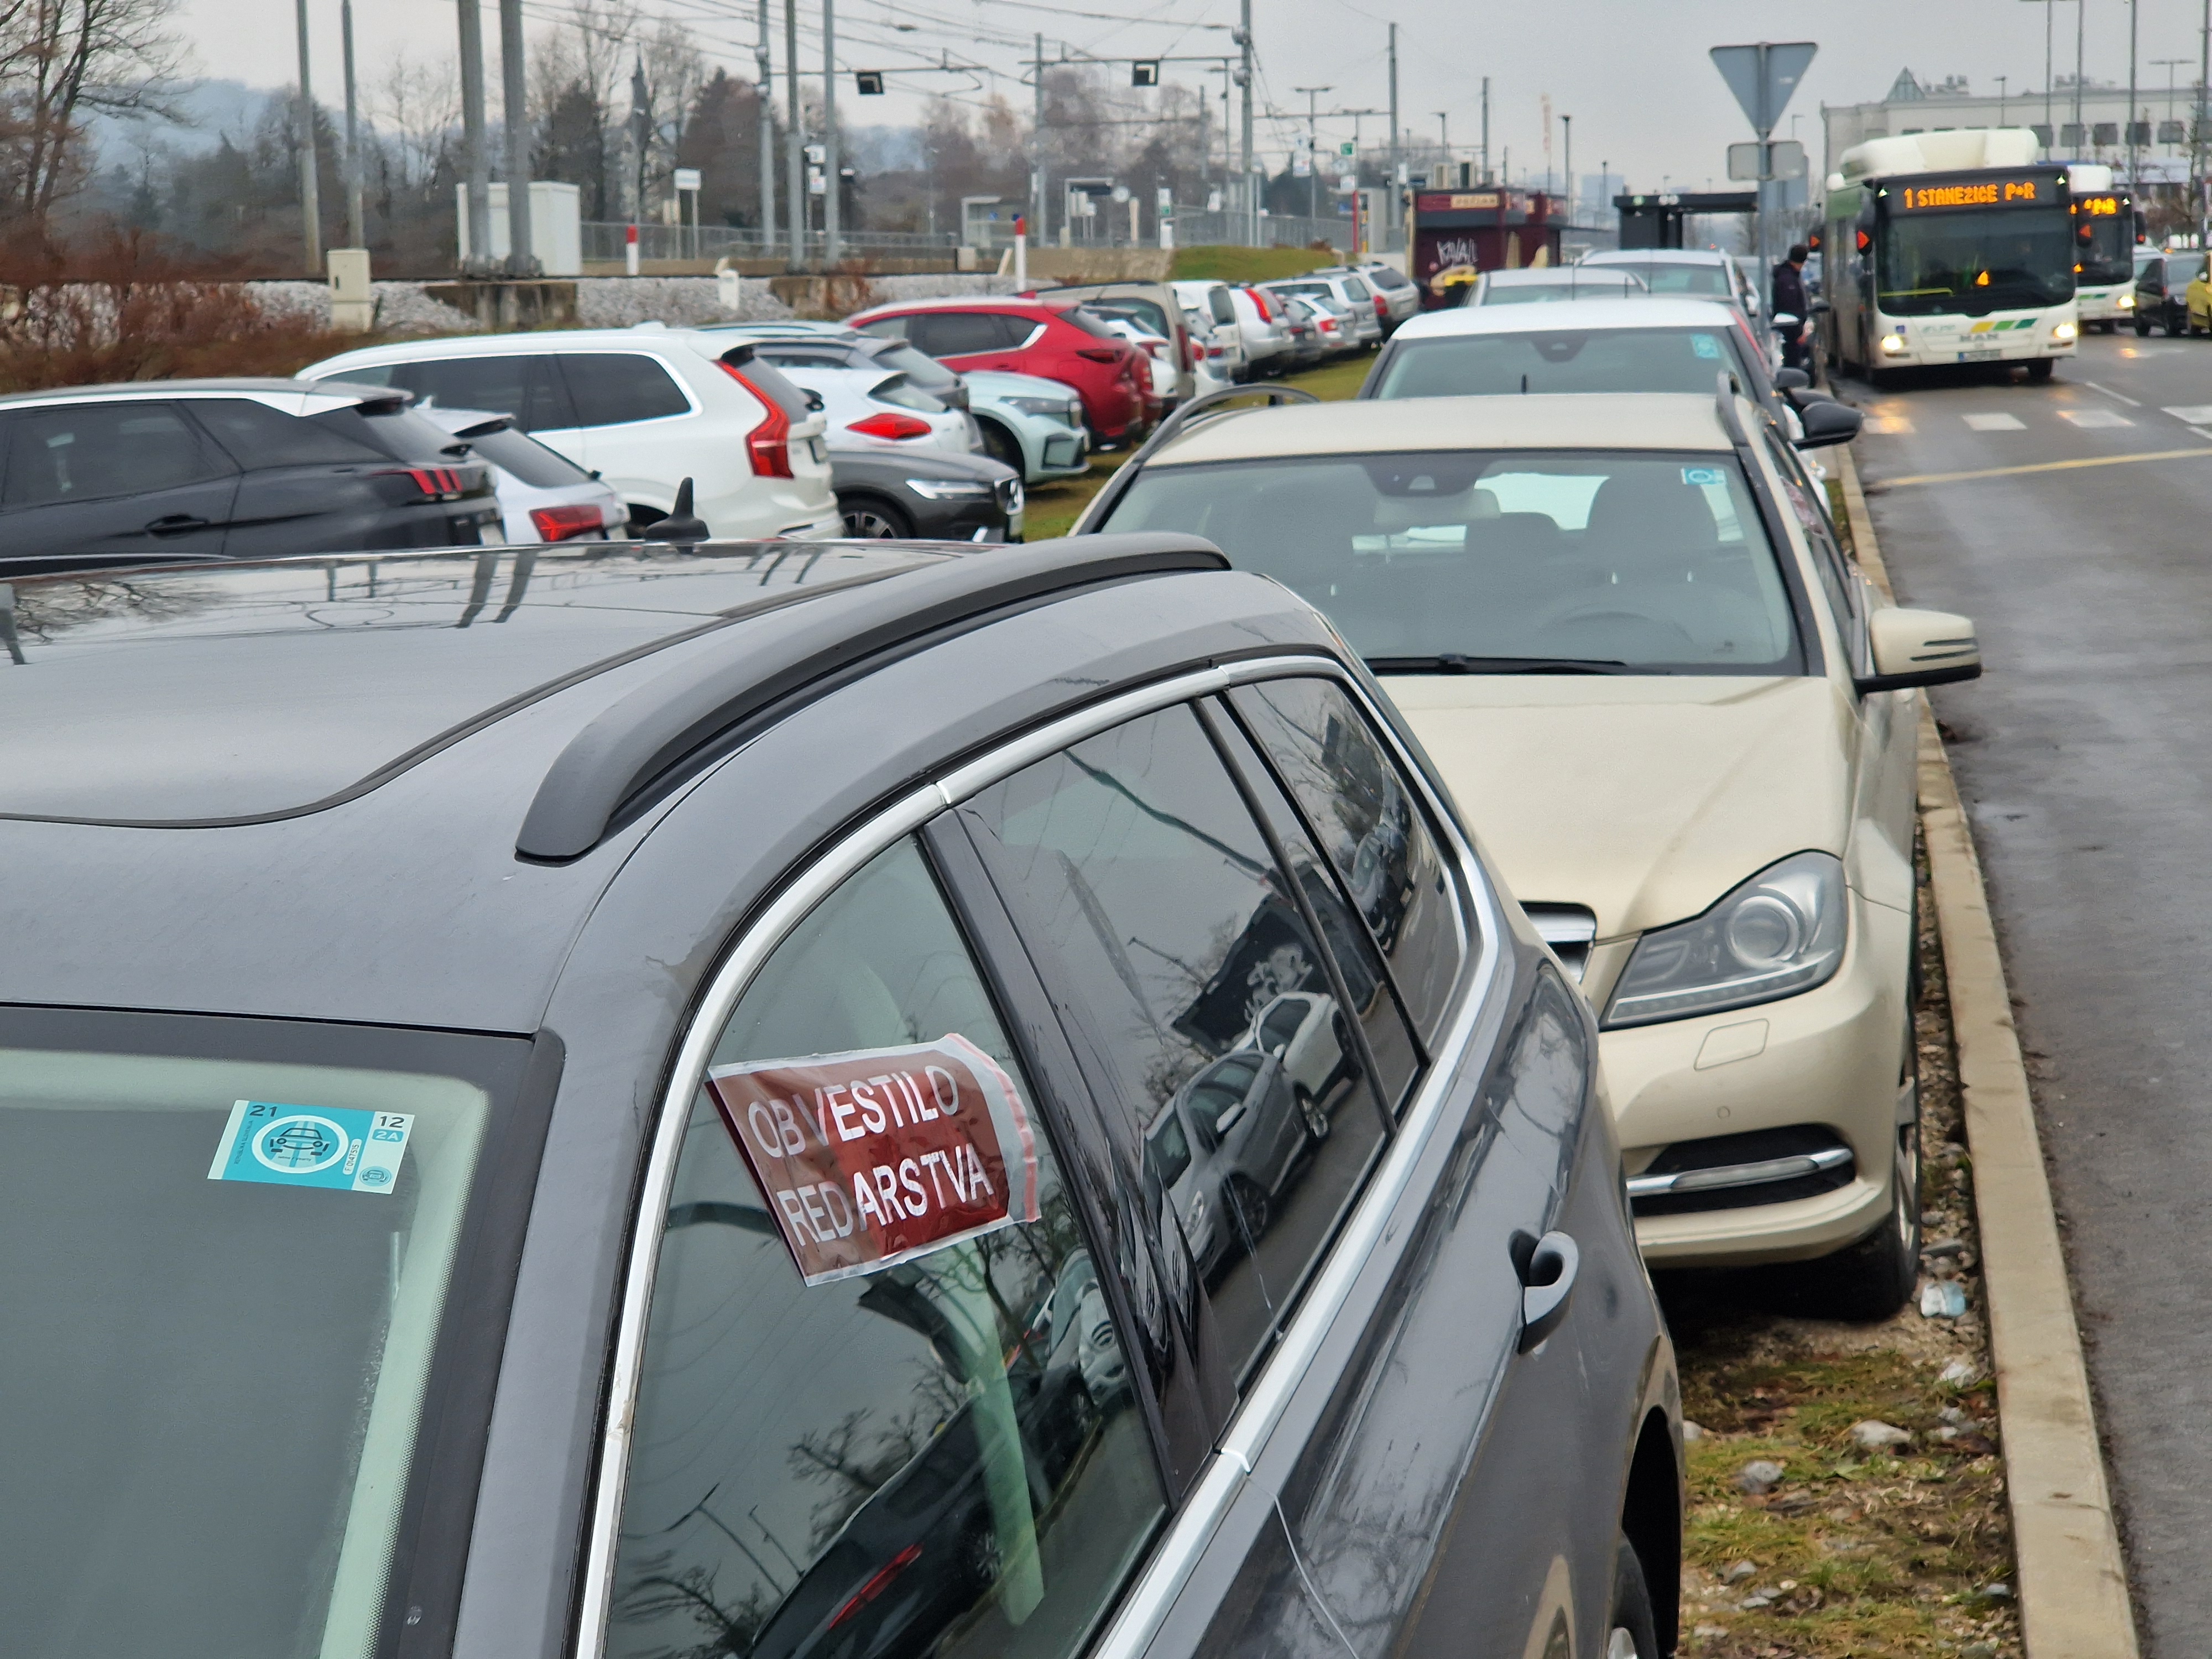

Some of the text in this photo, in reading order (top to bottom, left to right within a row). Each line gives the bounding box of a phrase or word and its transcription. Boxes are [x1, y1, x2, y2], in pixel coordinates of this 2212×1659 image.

[1904, 187, 1913, 208] 1
[249, 1105, 278, 1118] 21
[380, 1115, 404, 1128] 12
[749, 1065, 959, 1158] OBVESTILO
[375, 1131, 398, 1141] 2A
[346, 1144, 359, 1167] 0147515
[777, 1144, 994, 1246] REDARSTVA
